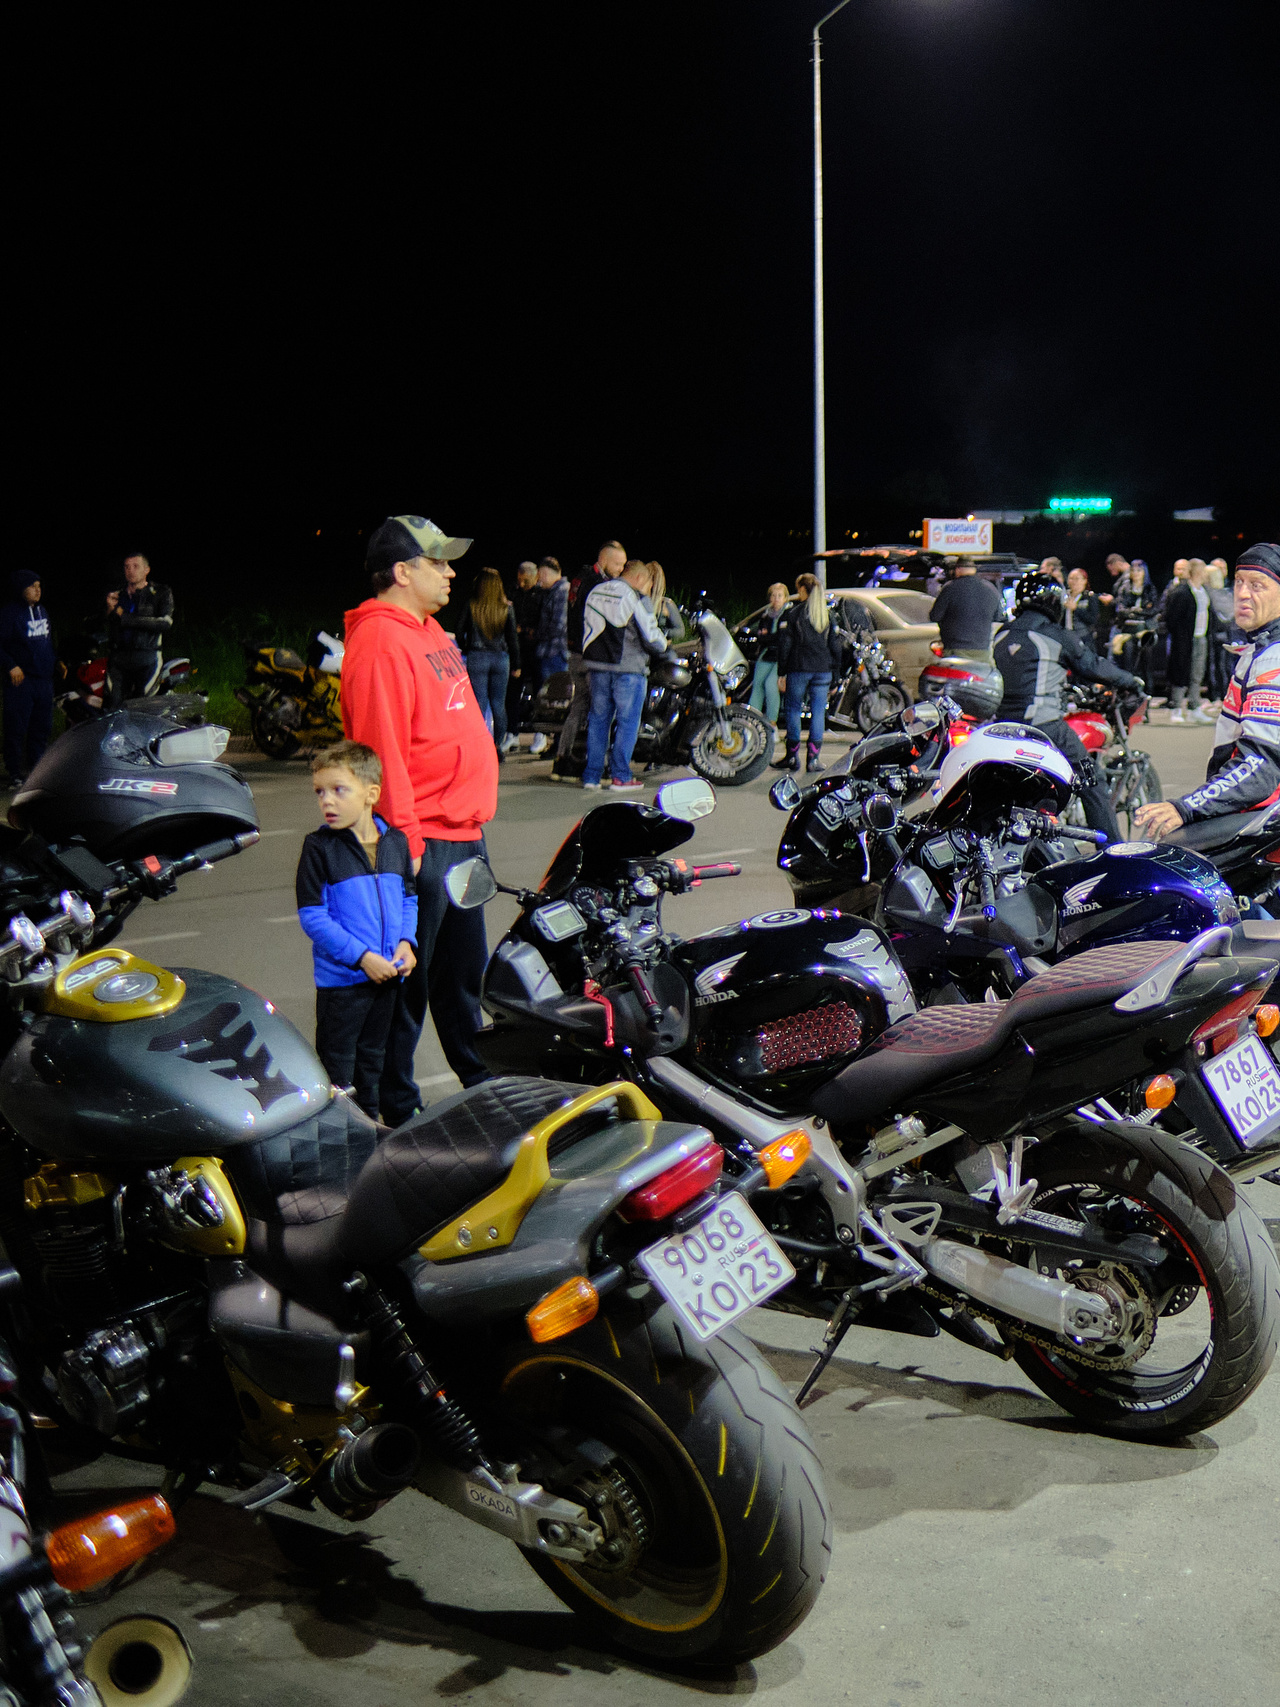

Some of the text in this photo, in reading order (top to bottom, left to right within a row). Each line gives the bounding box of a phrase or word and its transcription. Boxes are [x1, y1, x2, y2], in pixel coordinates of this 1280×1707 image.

[99, 778, 178, 796] JK-2
[1184, 753, 1265, 809] HONDA
[1062, 901, 1103, 917] HONDA
[839, 936, 874, 952] HONDA
[695, 990, 739, 1007] HONDA
[1214, 1044, 1259, 1092] 7867
[1245, 1073, 1261, 1088] RUS
[1230, 1096, 1262, 1131] KO
[663, 1209, 745, 1278] 9068
[717, 1246, 744, 1269] RUS
[685, 1247, 783, 1331] KO 23
[1164, 1381, 1195, 1405] HONDA
[470, 1489, 515, 1518] OKADA
